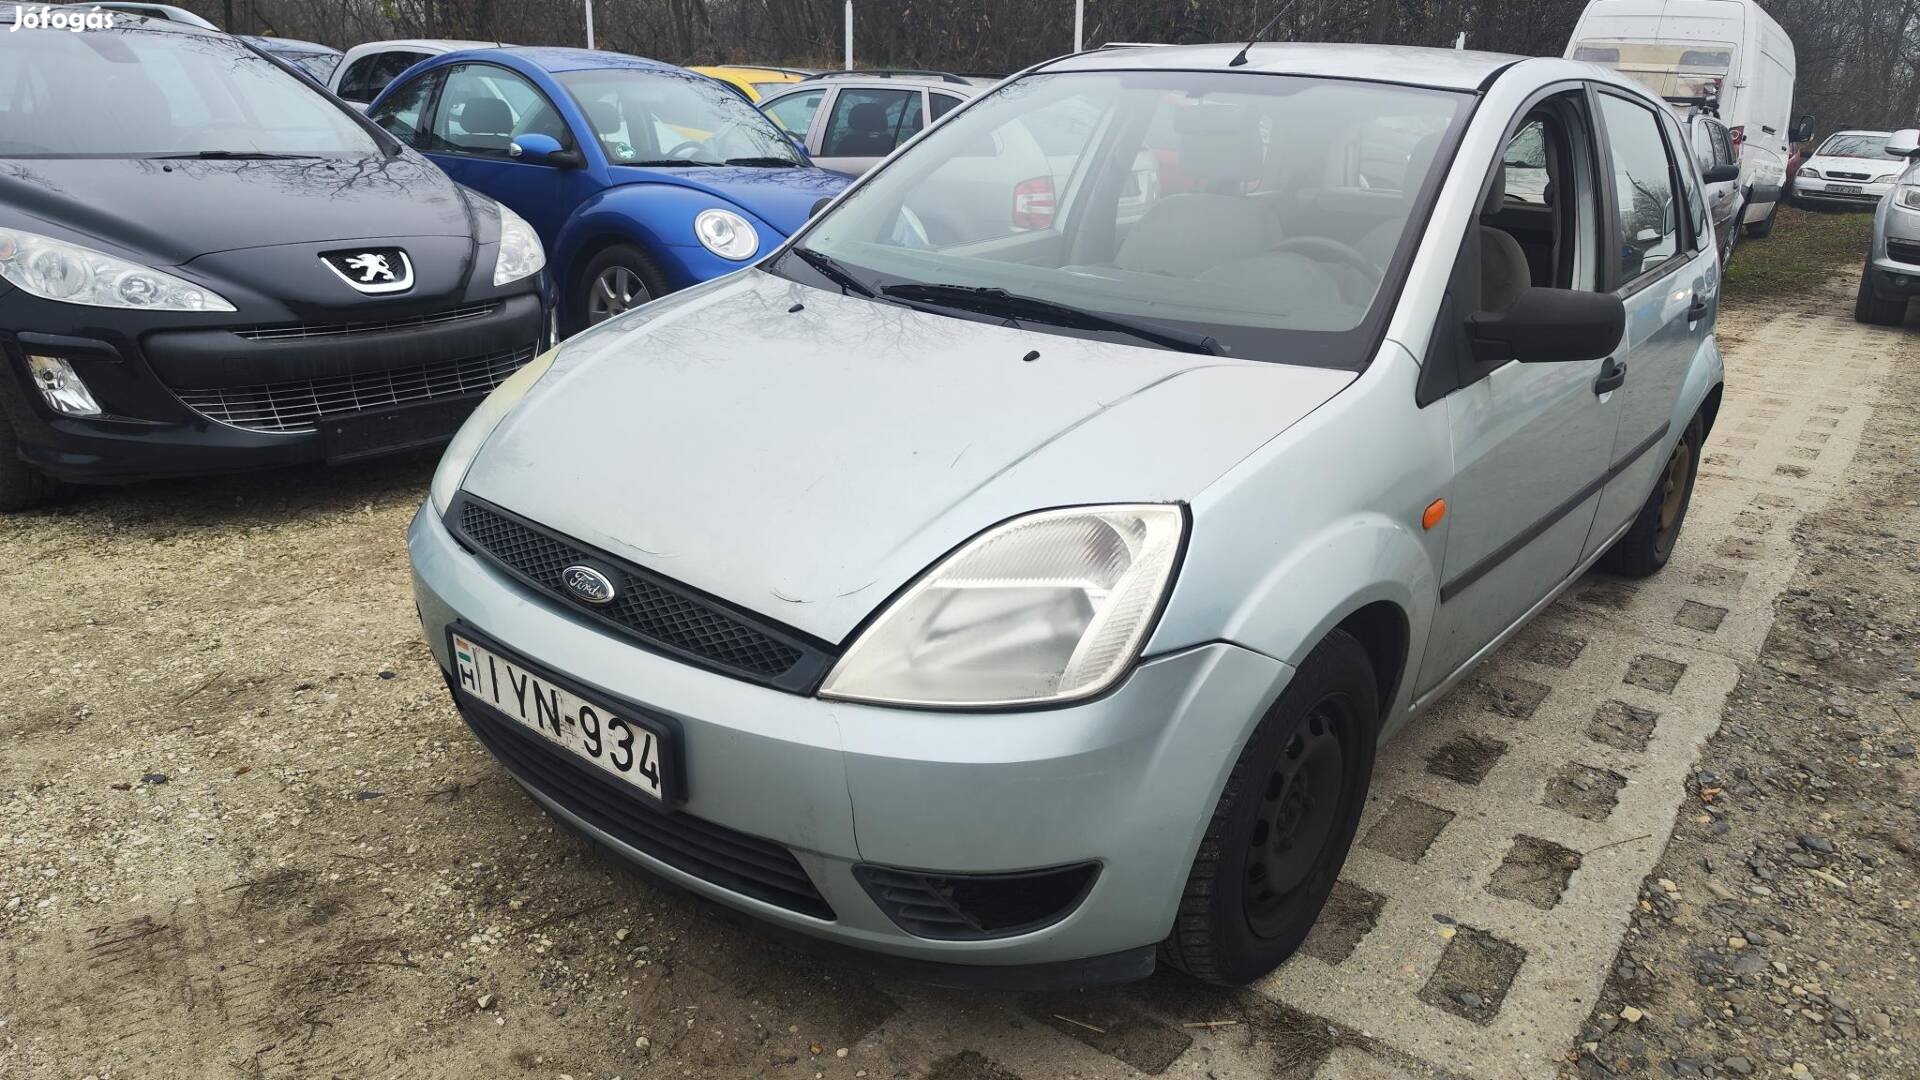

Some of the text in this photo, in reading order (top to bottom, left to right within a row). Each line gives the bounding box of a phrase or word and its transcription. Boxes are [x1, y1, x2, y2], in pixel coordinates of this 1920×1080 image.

[570, 571, 600, 596] Ford
[460, 663, 476, 691] H
[488, 655, 660, 790] IYN-934
